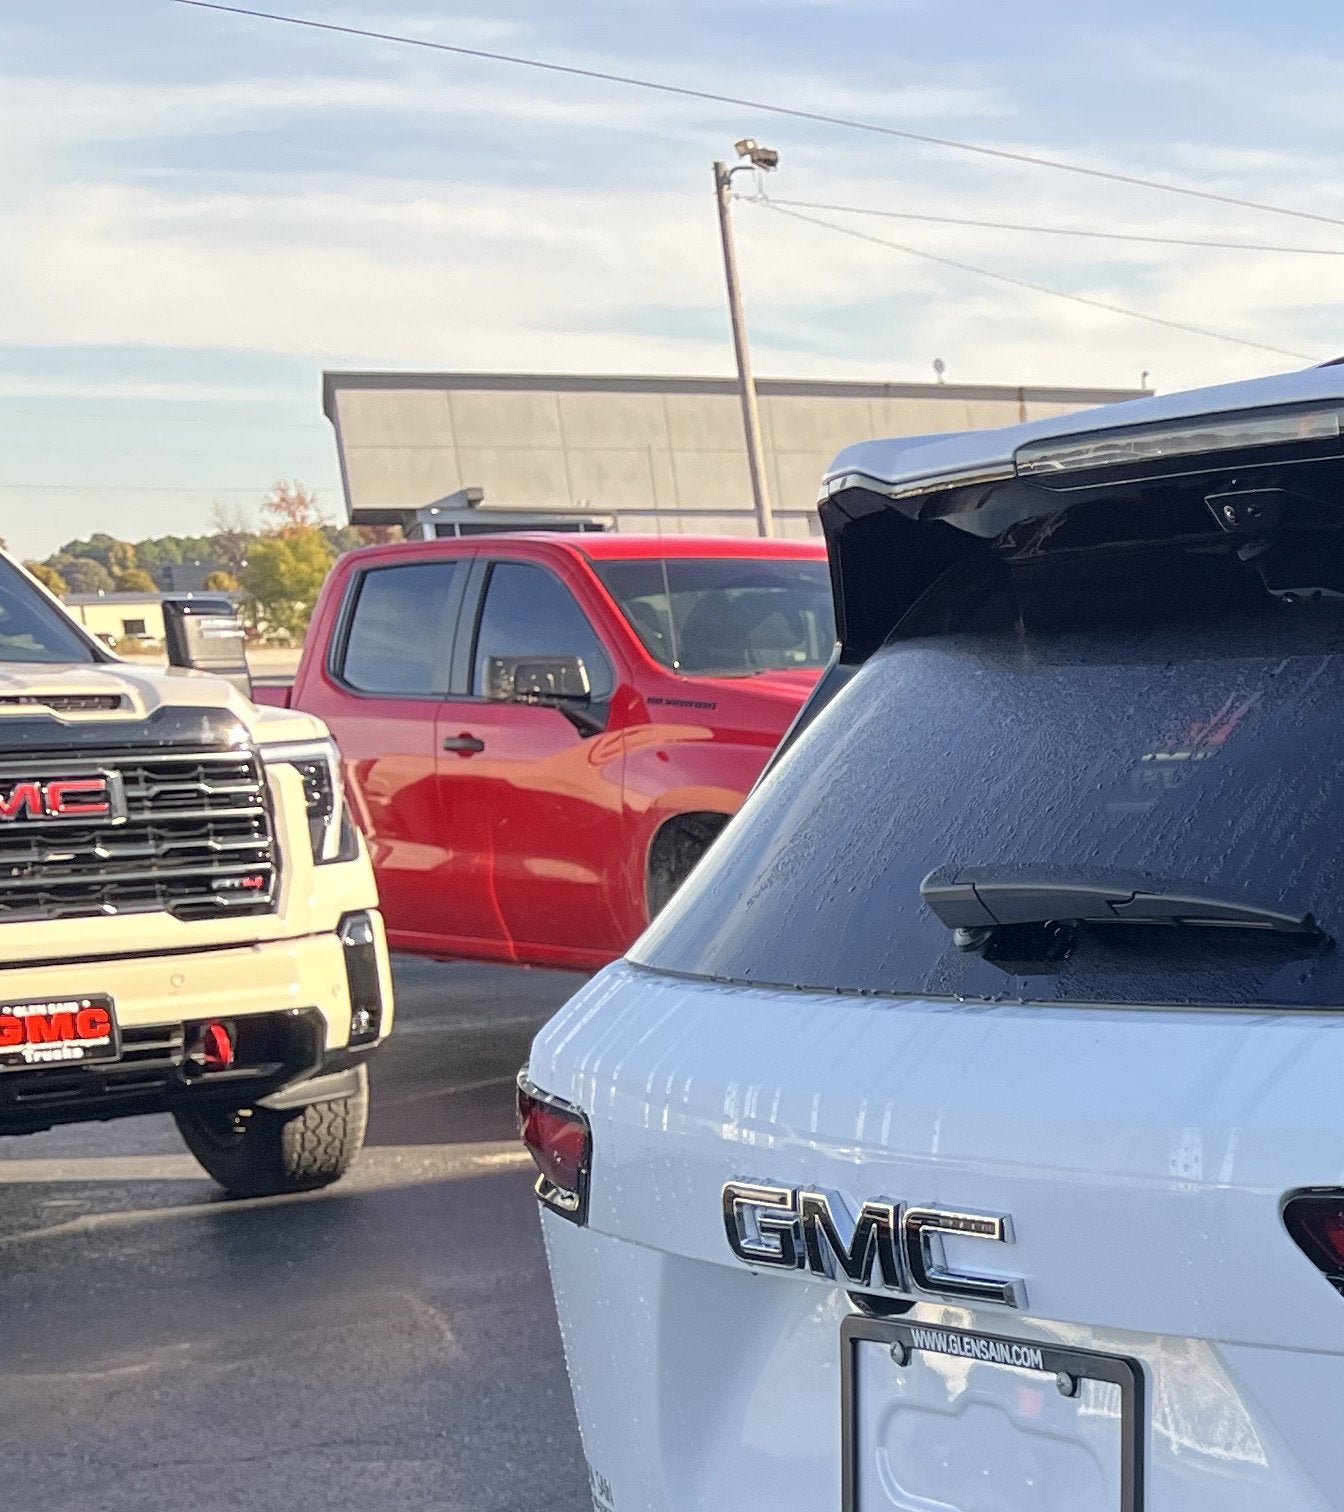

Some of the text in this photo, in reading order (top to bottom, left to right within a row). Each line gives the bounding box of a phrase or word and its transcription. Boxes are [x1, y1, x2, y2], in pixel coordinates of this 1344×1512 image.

[0, 779, 109, 820] MC
[0, 1008, 111, 1046] GMC
[722, 1179, 1029, 1309] GMC
[911, 1328, 1044, 1369] WWW.GLENSAIN.COM
